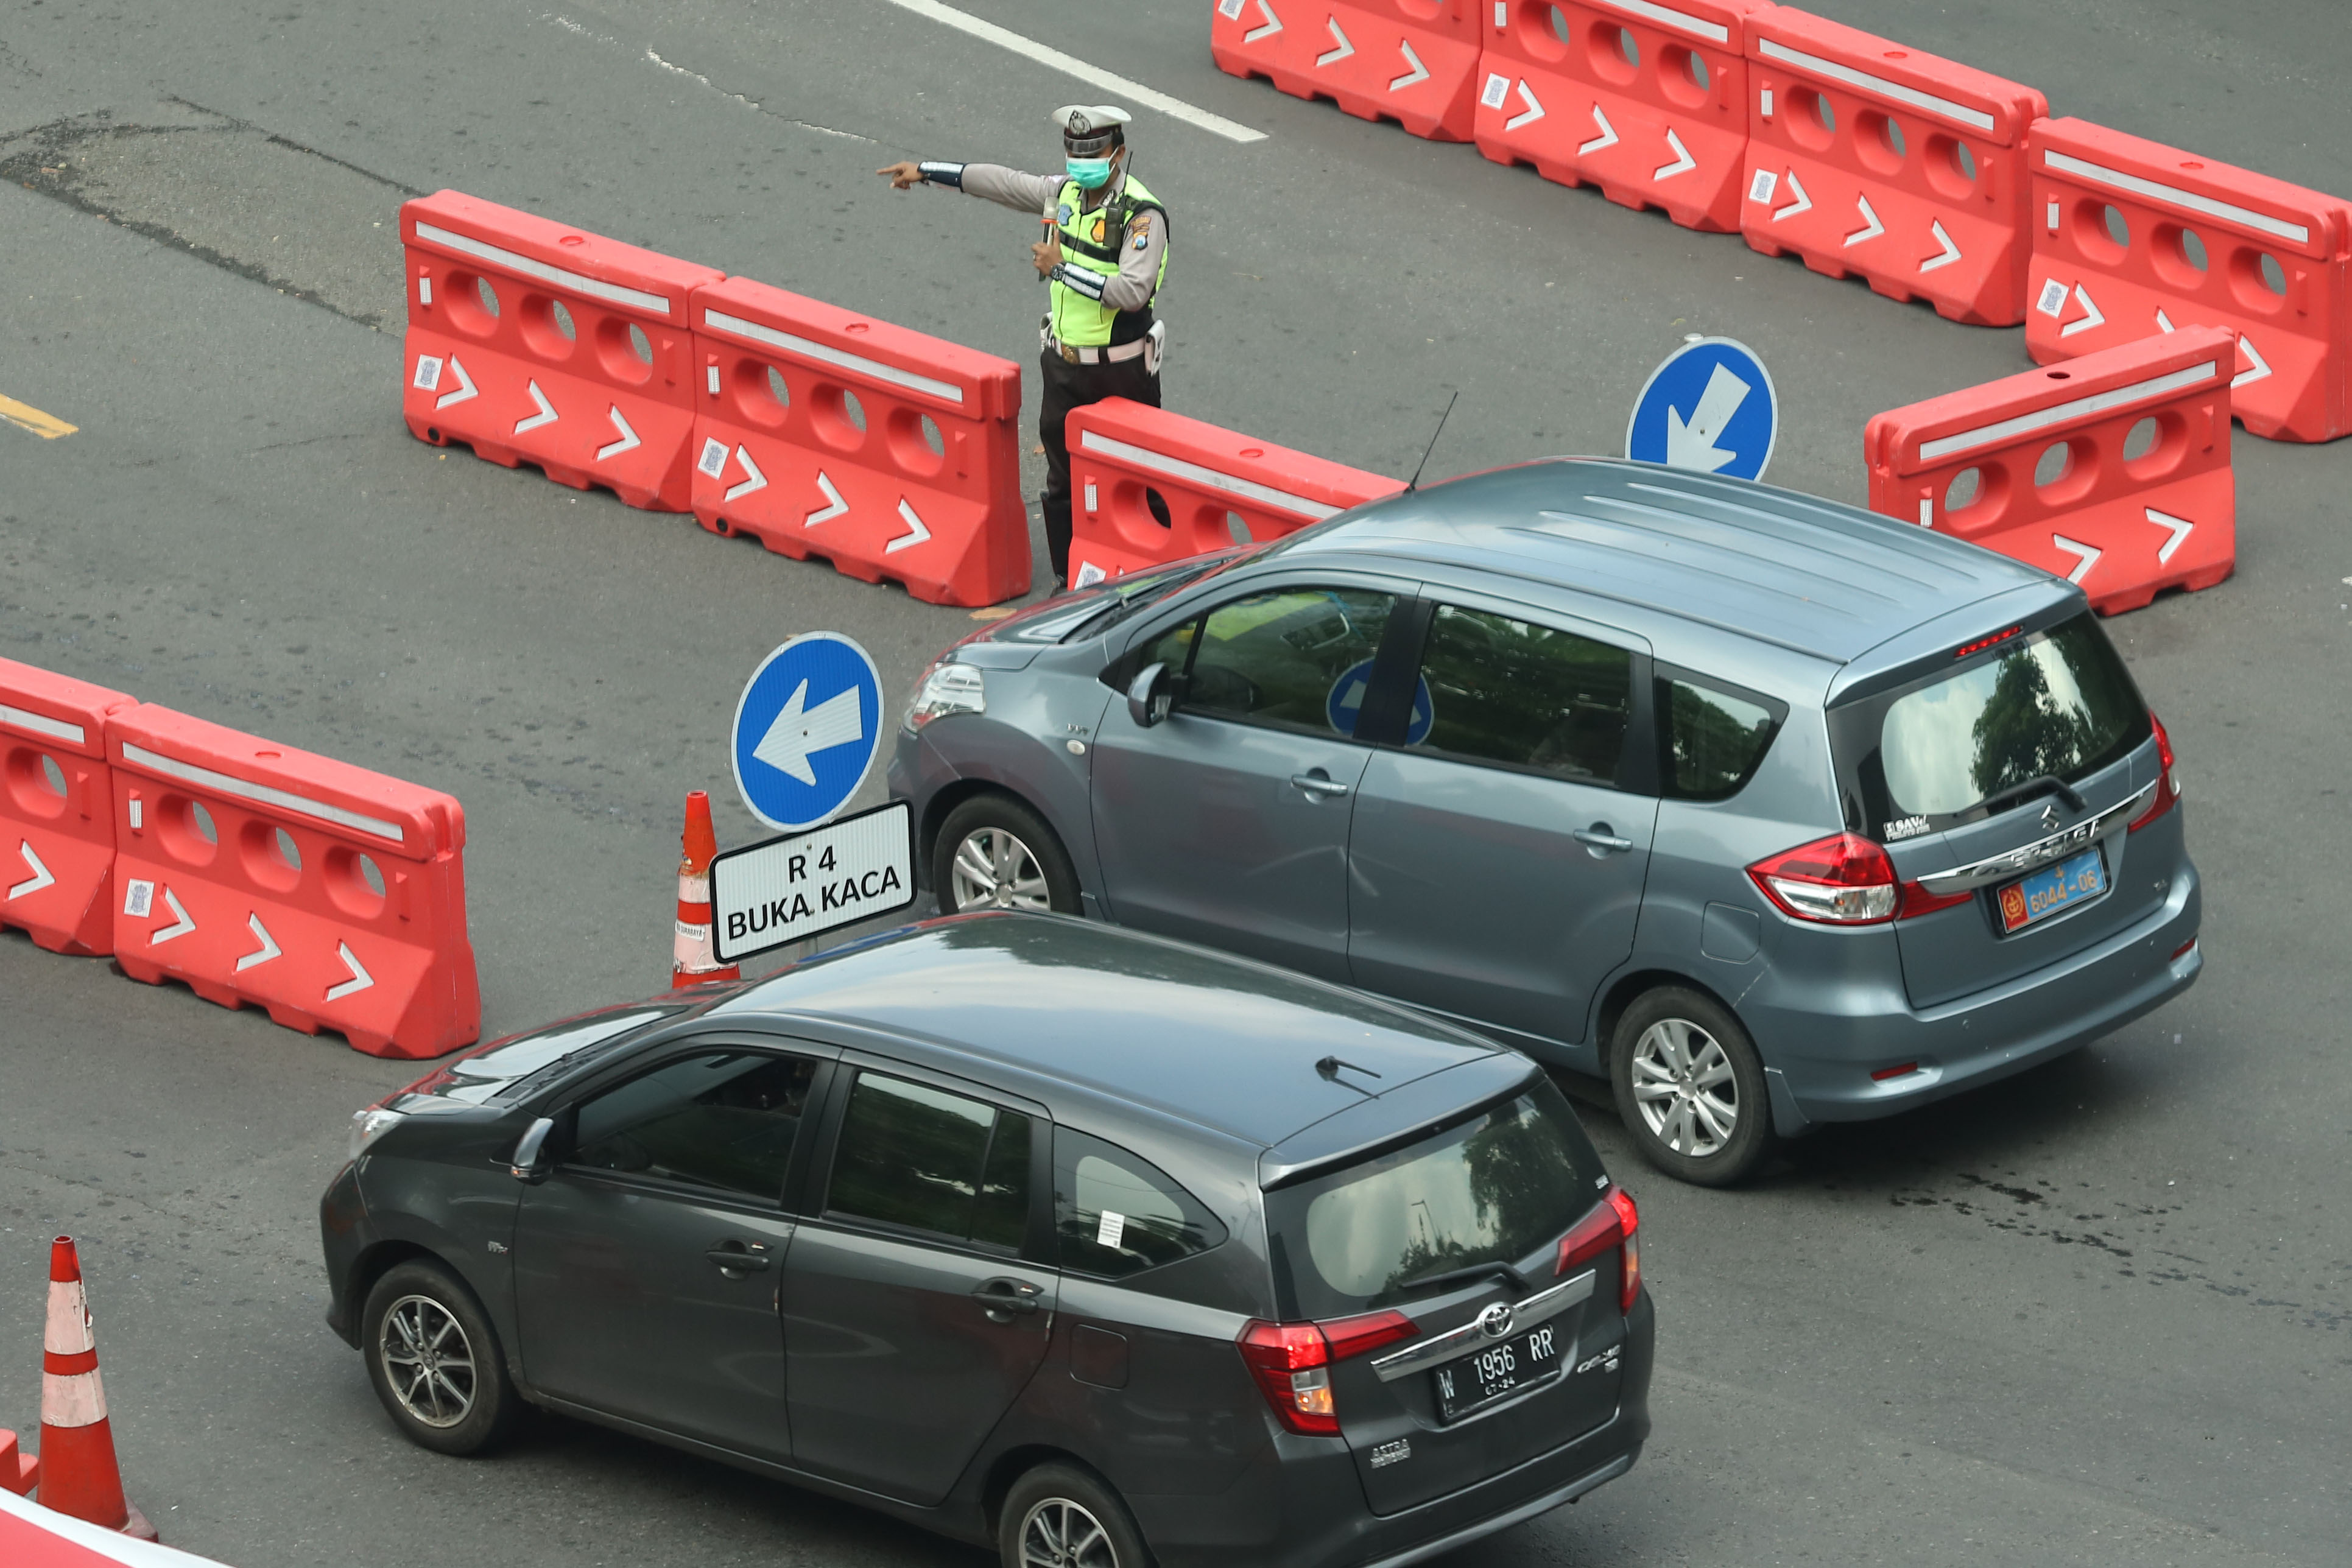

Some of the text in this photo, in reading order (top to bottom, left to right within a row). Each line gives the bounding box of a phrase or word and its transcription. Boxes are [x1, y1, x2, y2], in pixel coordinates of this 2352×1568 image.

[789, 845, 837, 884] R 4
[728, 866, 901, 940] BUKA KACA
[1474, 1345, 1516, 1383] 1956
[1529, 1329, 1555, 1361] RR
